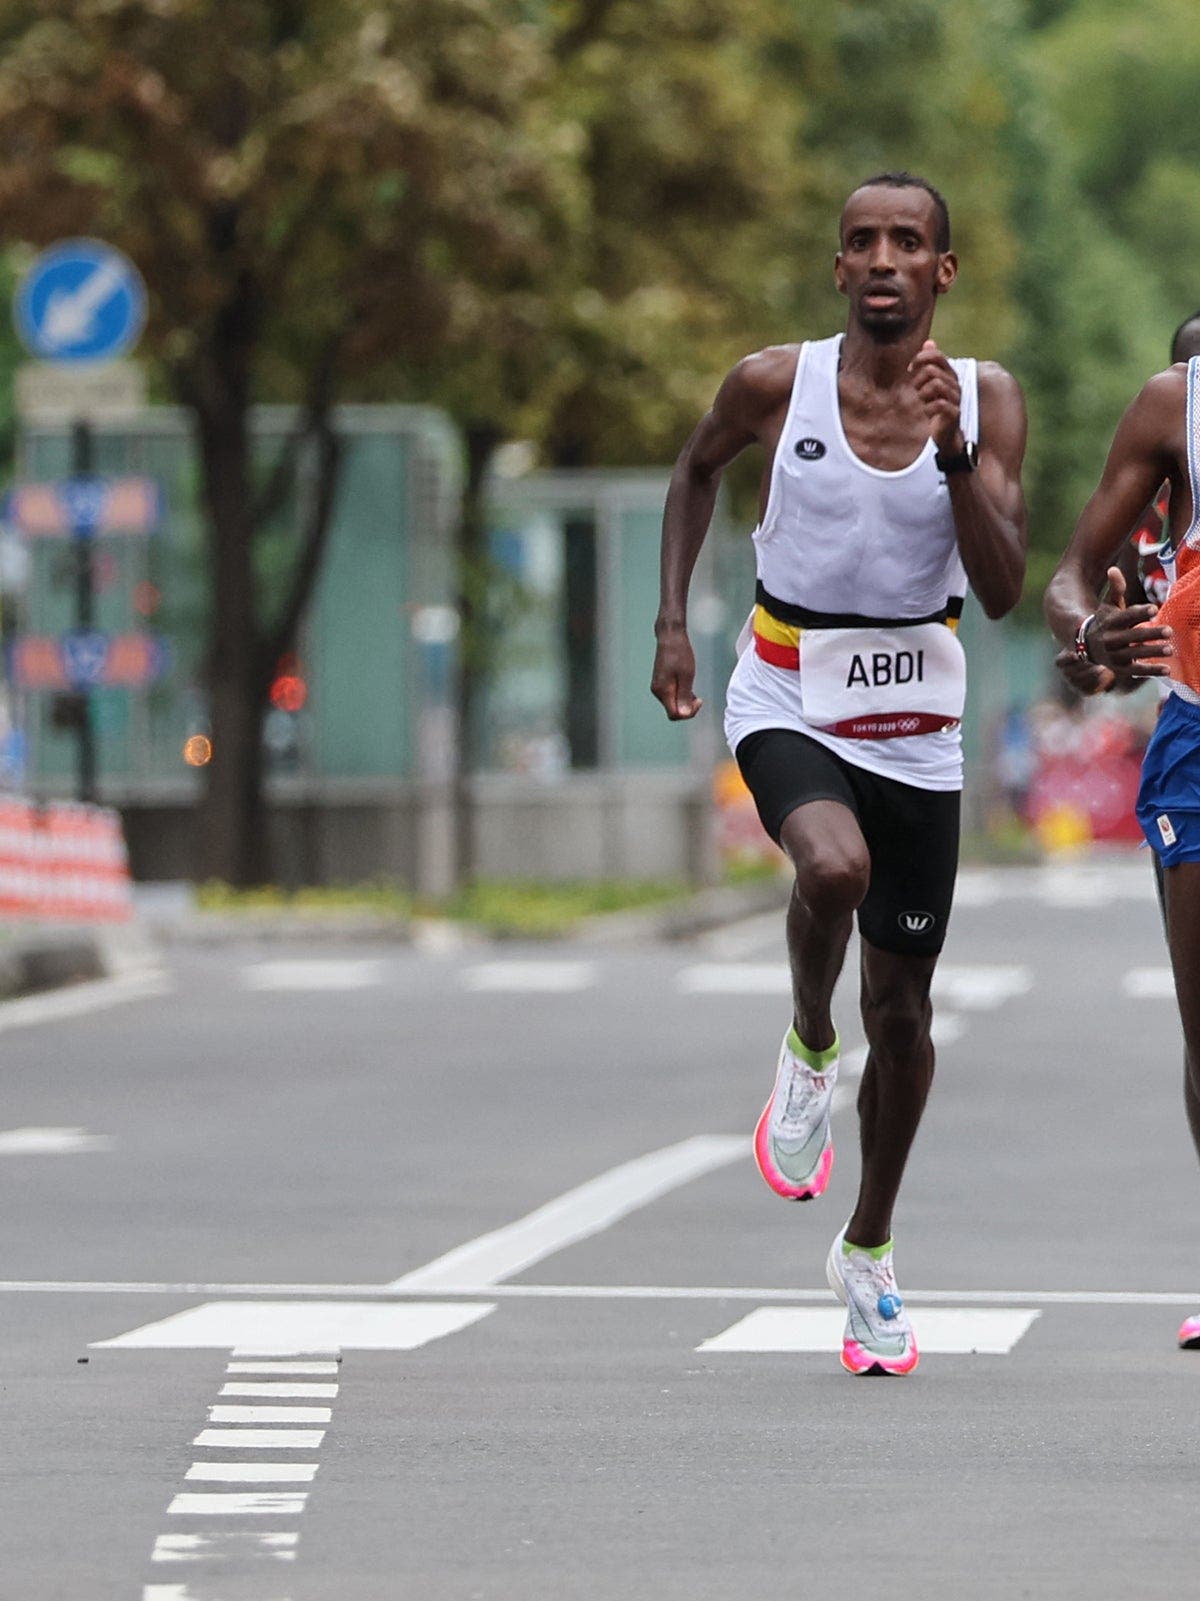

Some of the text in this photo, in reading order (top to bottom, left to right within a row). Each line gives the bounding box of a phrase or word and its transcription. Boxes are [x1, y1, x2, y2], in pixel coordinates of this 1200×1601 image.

[846, 650, 924, 688] ABDI
[852, 722, 896, 733] TOKYO 2020
